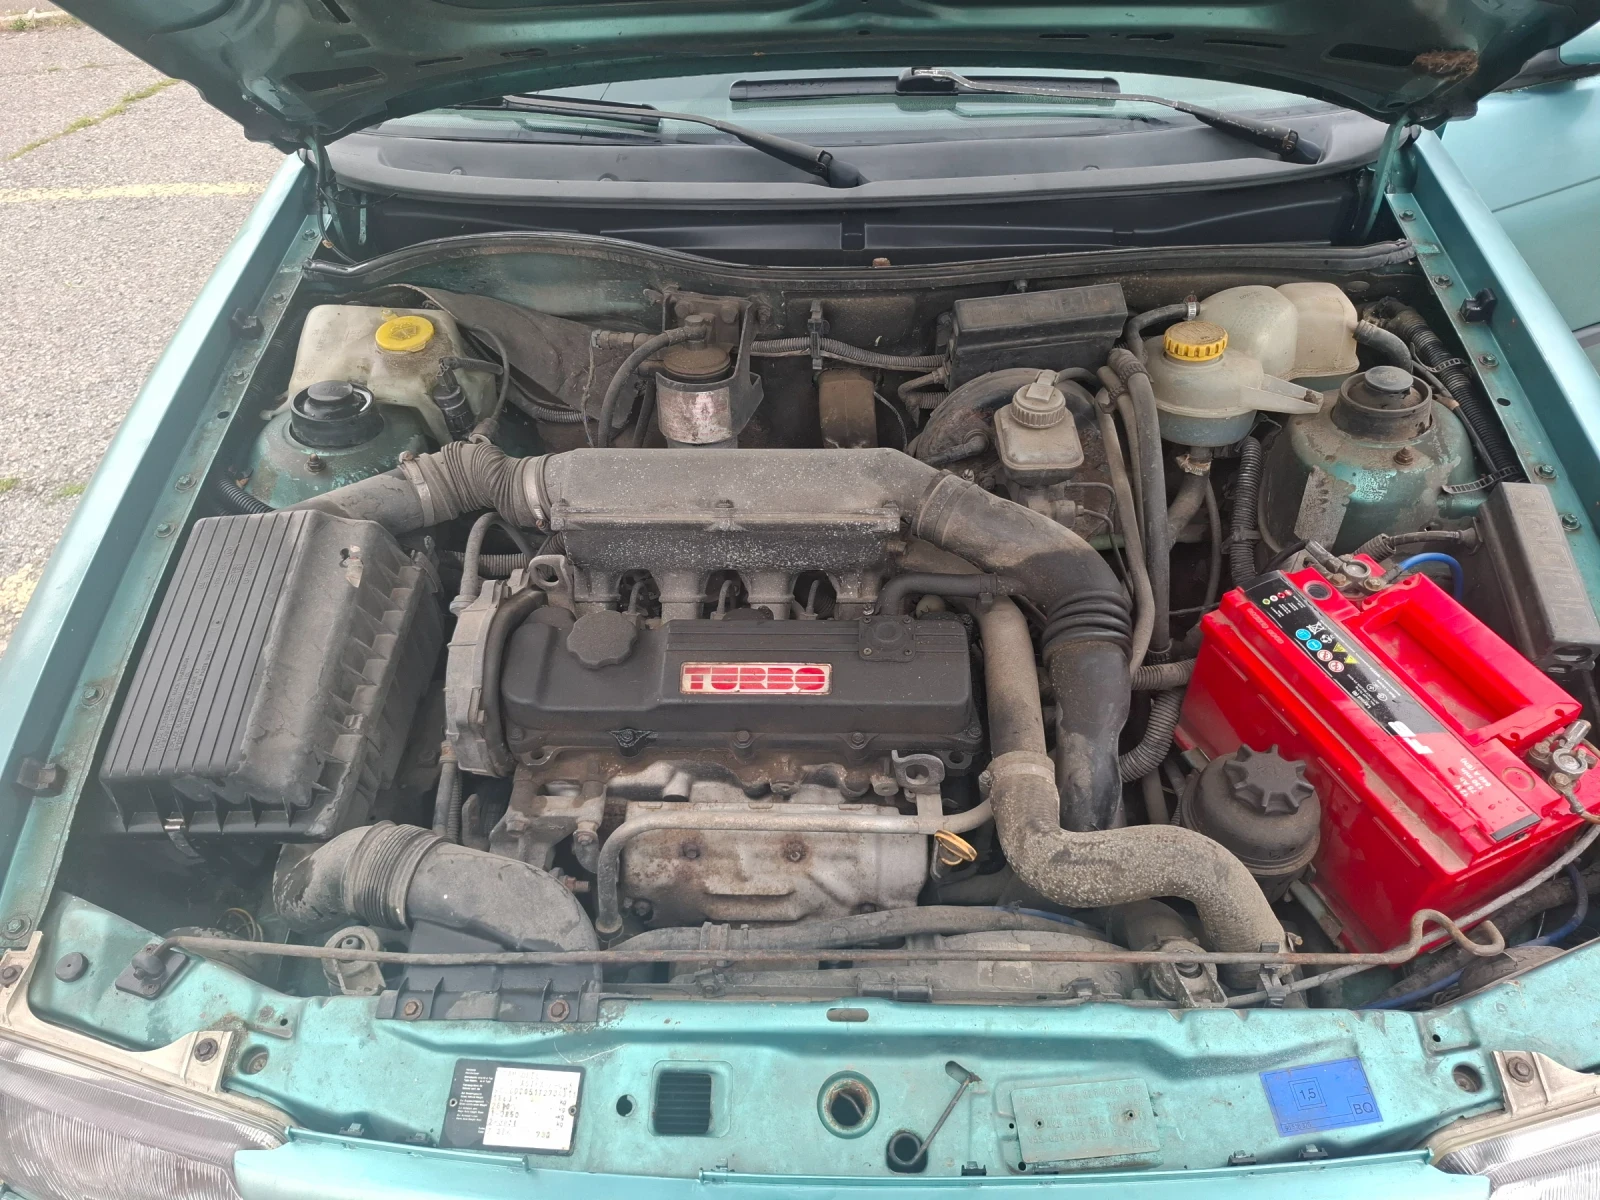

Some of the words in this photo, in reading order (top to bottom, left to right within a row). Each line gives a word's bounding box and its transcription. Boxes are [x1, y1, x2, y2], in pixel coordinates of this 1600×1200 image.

[685, 667, 825, 690] TURBO
[1300, 1088, 1316, 1101] 1,5
[1353, 1102, 1374, 1115] BQ
